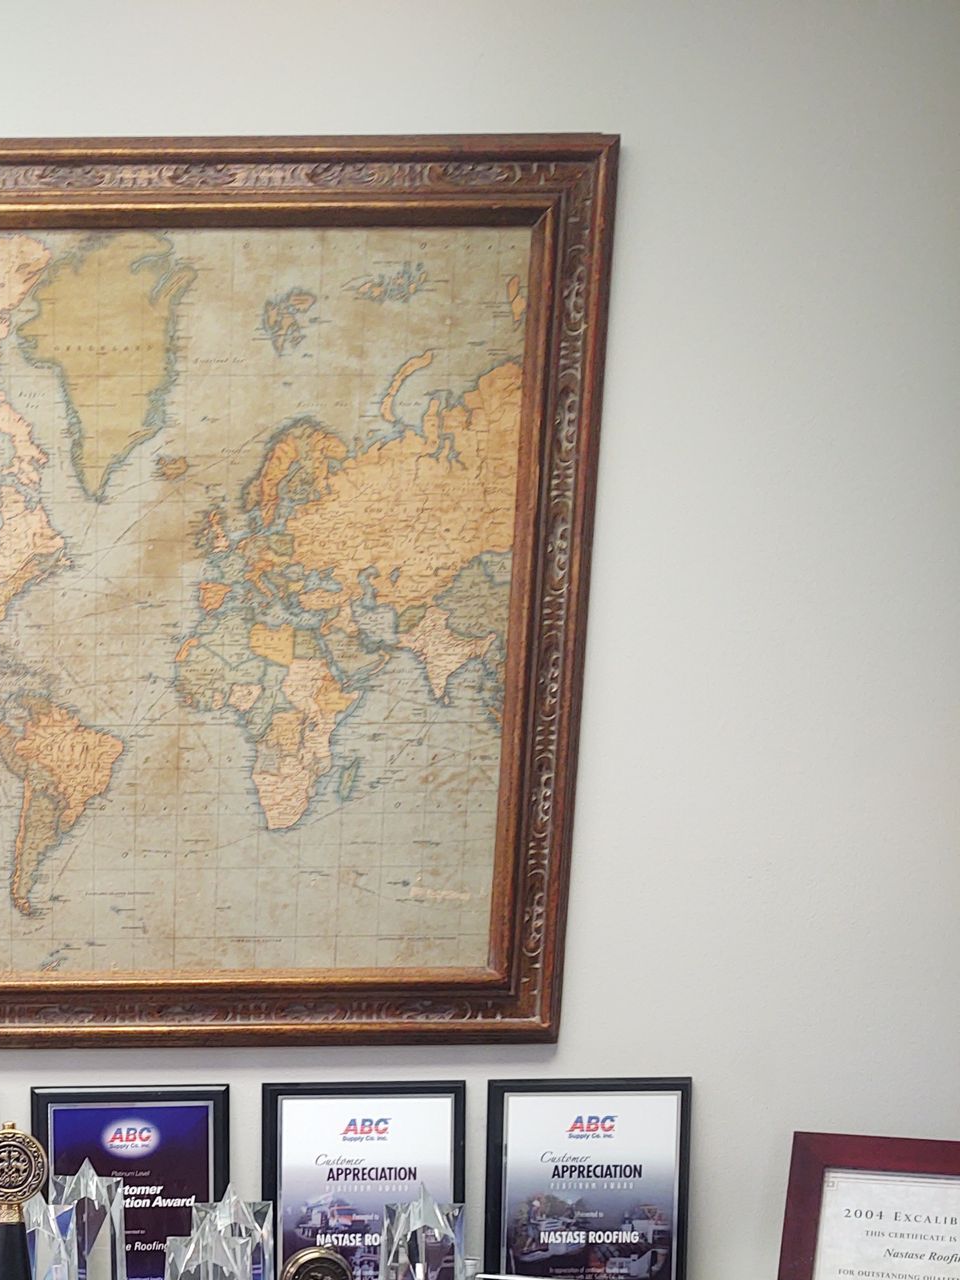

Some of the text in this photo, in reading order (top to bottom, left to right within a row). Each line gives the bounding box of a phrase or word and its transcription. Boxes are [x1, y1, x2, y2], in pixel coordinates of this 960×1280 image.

[340, 1117, 391, 1135] ABC
[566, 1115, 618, 1132] ABC
[107, 1127, 154, 1143] ABC
[315, 1153, 365, 1166] Customer
[540, 1151, 591, 1164] Customer
[327, 1167, 417, 1181] APPRECIATION
[552, 1164, 642, 1179] APPRECIATION
[123, 1184, 163, 1196] tomer
[152, 1195, 195, 1208] Award
[844, 1208, 958, 1225] 2004 EXCALIB
[316, 1233, 362, 1246] NASTASE
[540, 1230, 640, 1244] NASTASE ROOFING
[865, 1230, 885, 1238] THIS
[888, 1231, 945, 1242] CERTIFICATE
[883, 1248, 960, 1265] Nastase Roofi
[838, 1268, 854, 1277] FOR
[857, 1270, 920, 1280] OUTSTANDING
